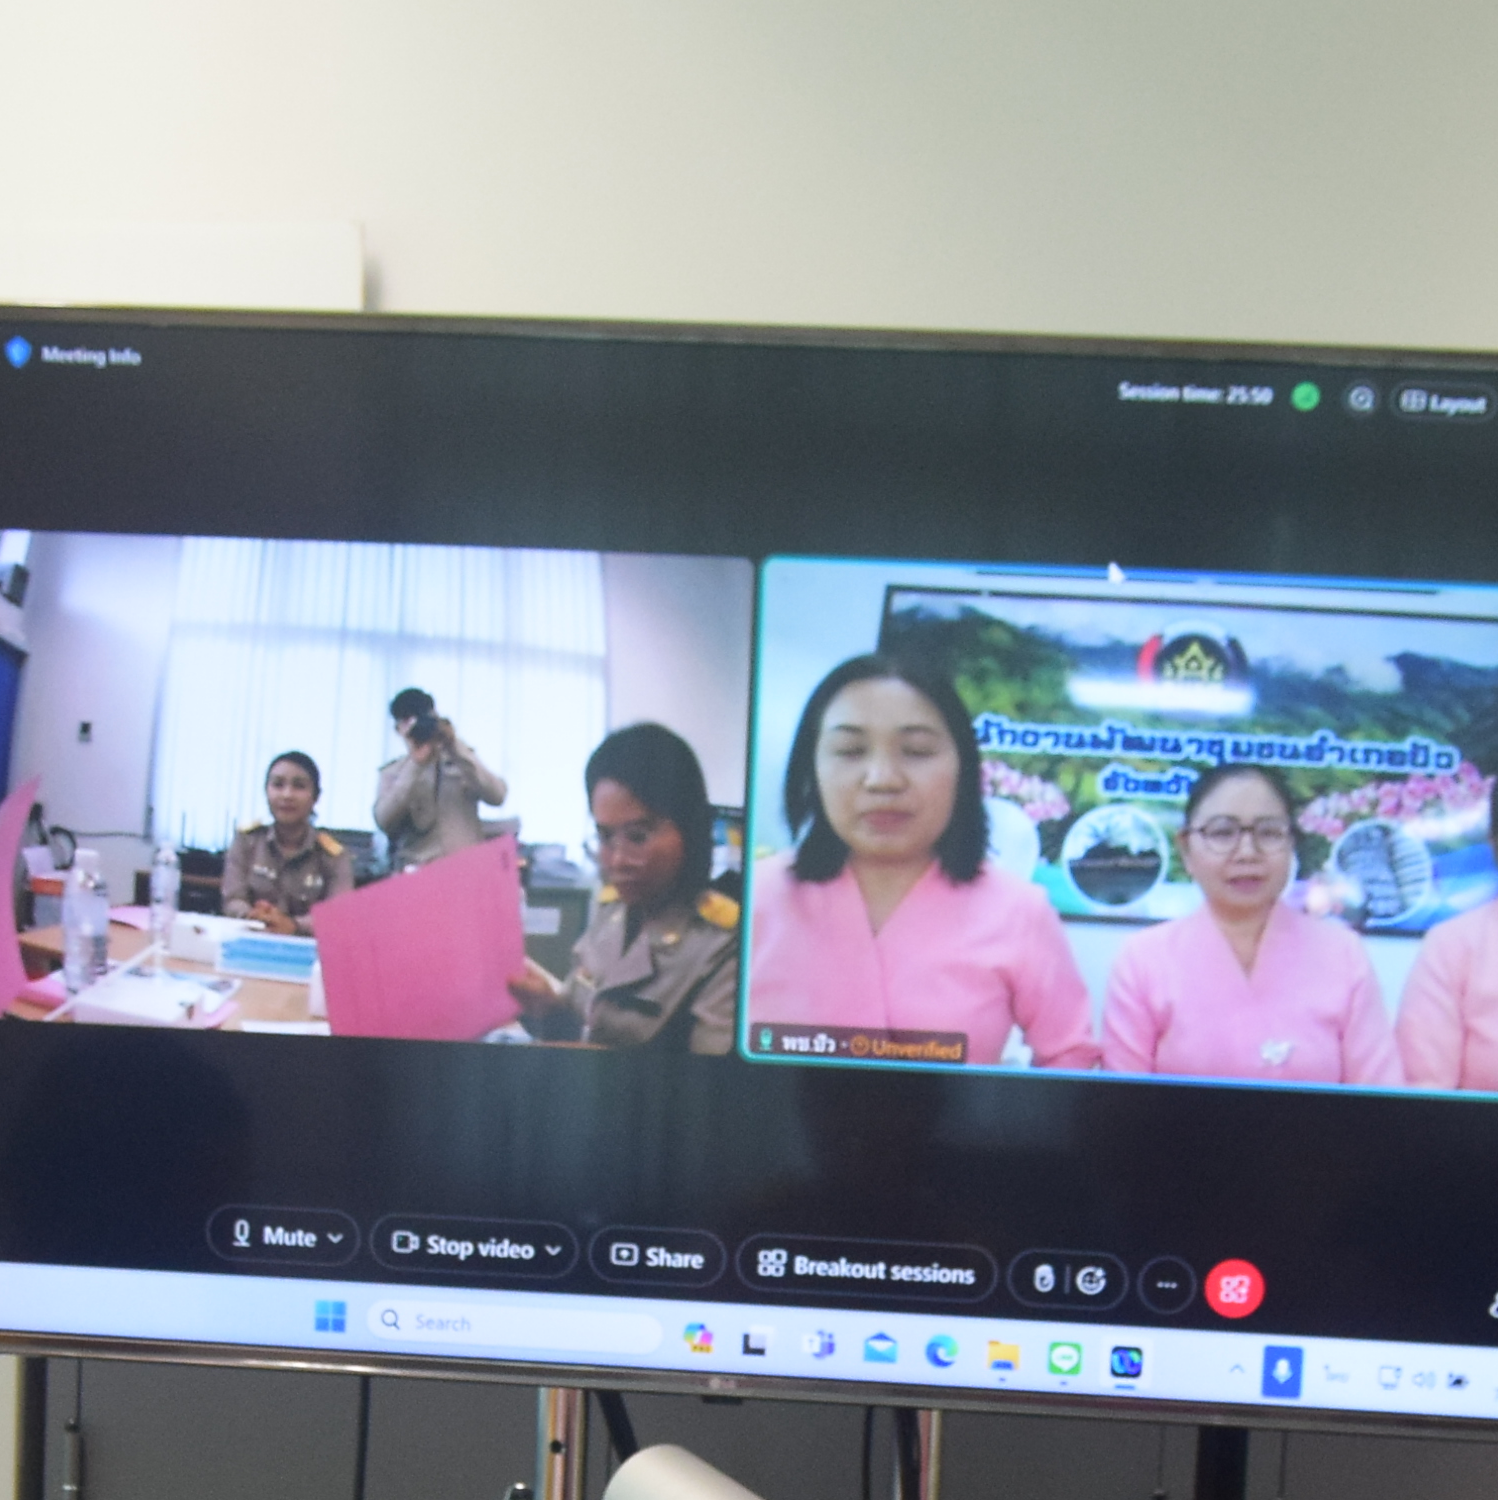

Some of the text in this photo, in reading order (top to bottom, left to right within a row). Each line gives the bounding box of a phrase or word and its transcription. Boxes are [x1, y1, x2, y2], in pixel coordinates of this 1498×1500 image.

[1117, 380, 1181, 402] Session
[1429, 393, 1487, 417] Layout
[873, 1038, 962, 1061] Unverified
[263, 1225, 317, 1249] Mute
[426, 1233, 535, 1261] Stop video
[646, 1246, 704, 1270] Share
[794, 1253, 976, 1287] Breakout sessions
[415, 1313, 472, 1334] Search
